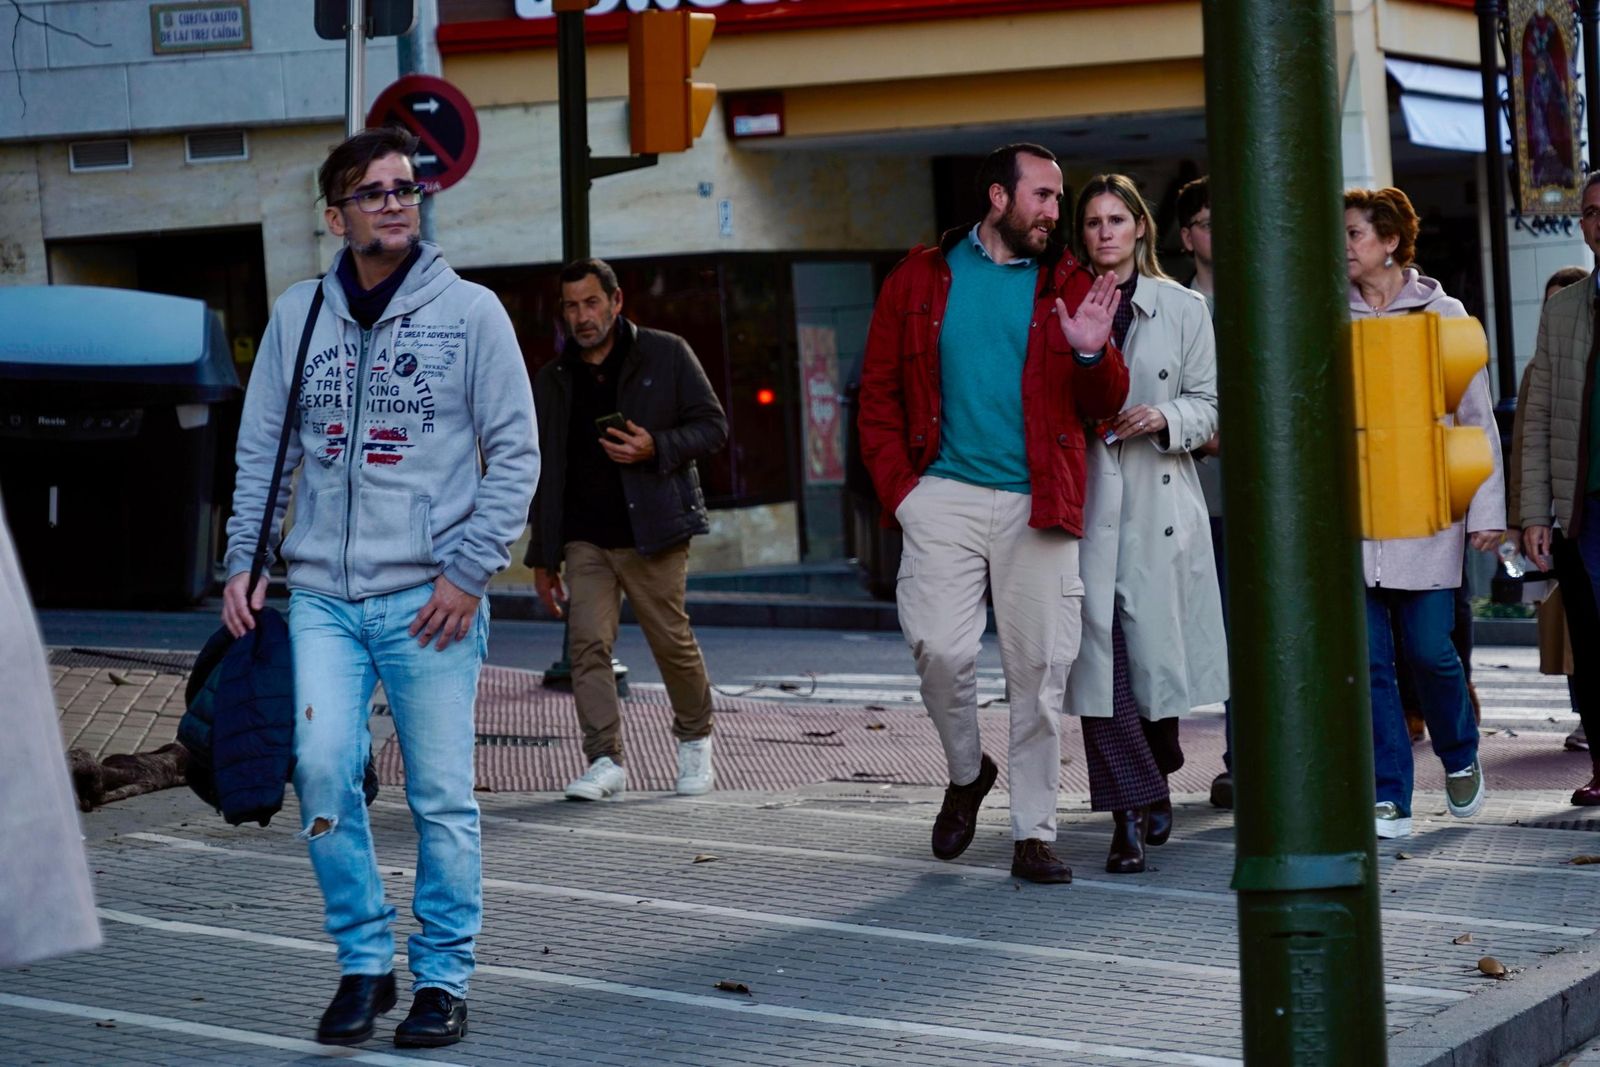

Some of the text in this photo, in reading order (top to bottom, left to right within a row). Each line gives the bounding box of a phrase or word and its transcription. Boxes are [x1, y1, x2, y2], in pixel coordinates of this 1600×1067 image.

[178, 10, 238, 25] CUESTA CRISTO
[160, 30, 171, 42] DE
[174, 29, 188, 41] LAS
[191, 28, 209, 40] TRES
[403, 330, 426, 339] GREAT
[427, 331, 467, 340] ADVENTURE
[37, 415, 66, 426] Resto
